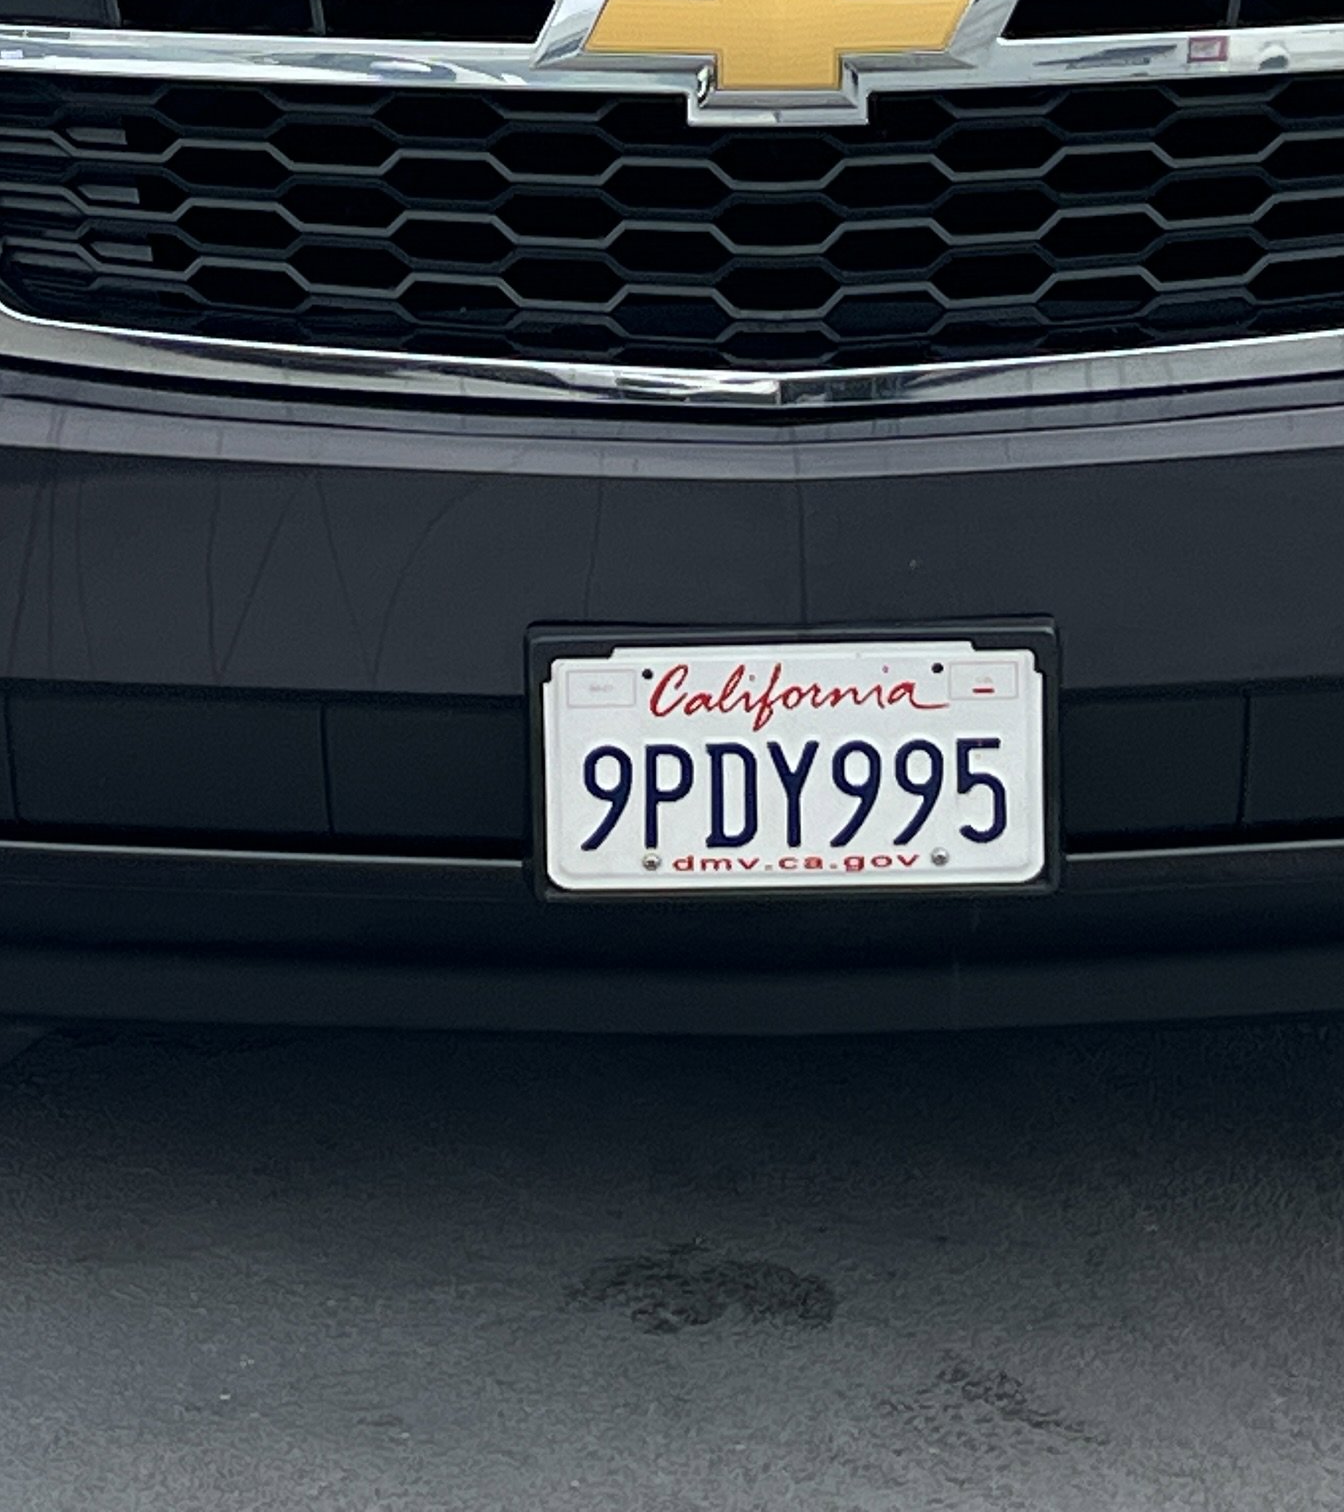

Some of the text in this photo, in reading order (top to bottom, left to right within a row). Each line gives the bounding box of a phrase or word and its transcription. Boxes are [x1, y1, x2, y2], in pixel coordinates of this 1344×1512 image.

[649, 663, 950, 731] California
[581, 738, 1008, 852] 9PDY995
[673, 853, 921, 873] dmv.ca.gov
